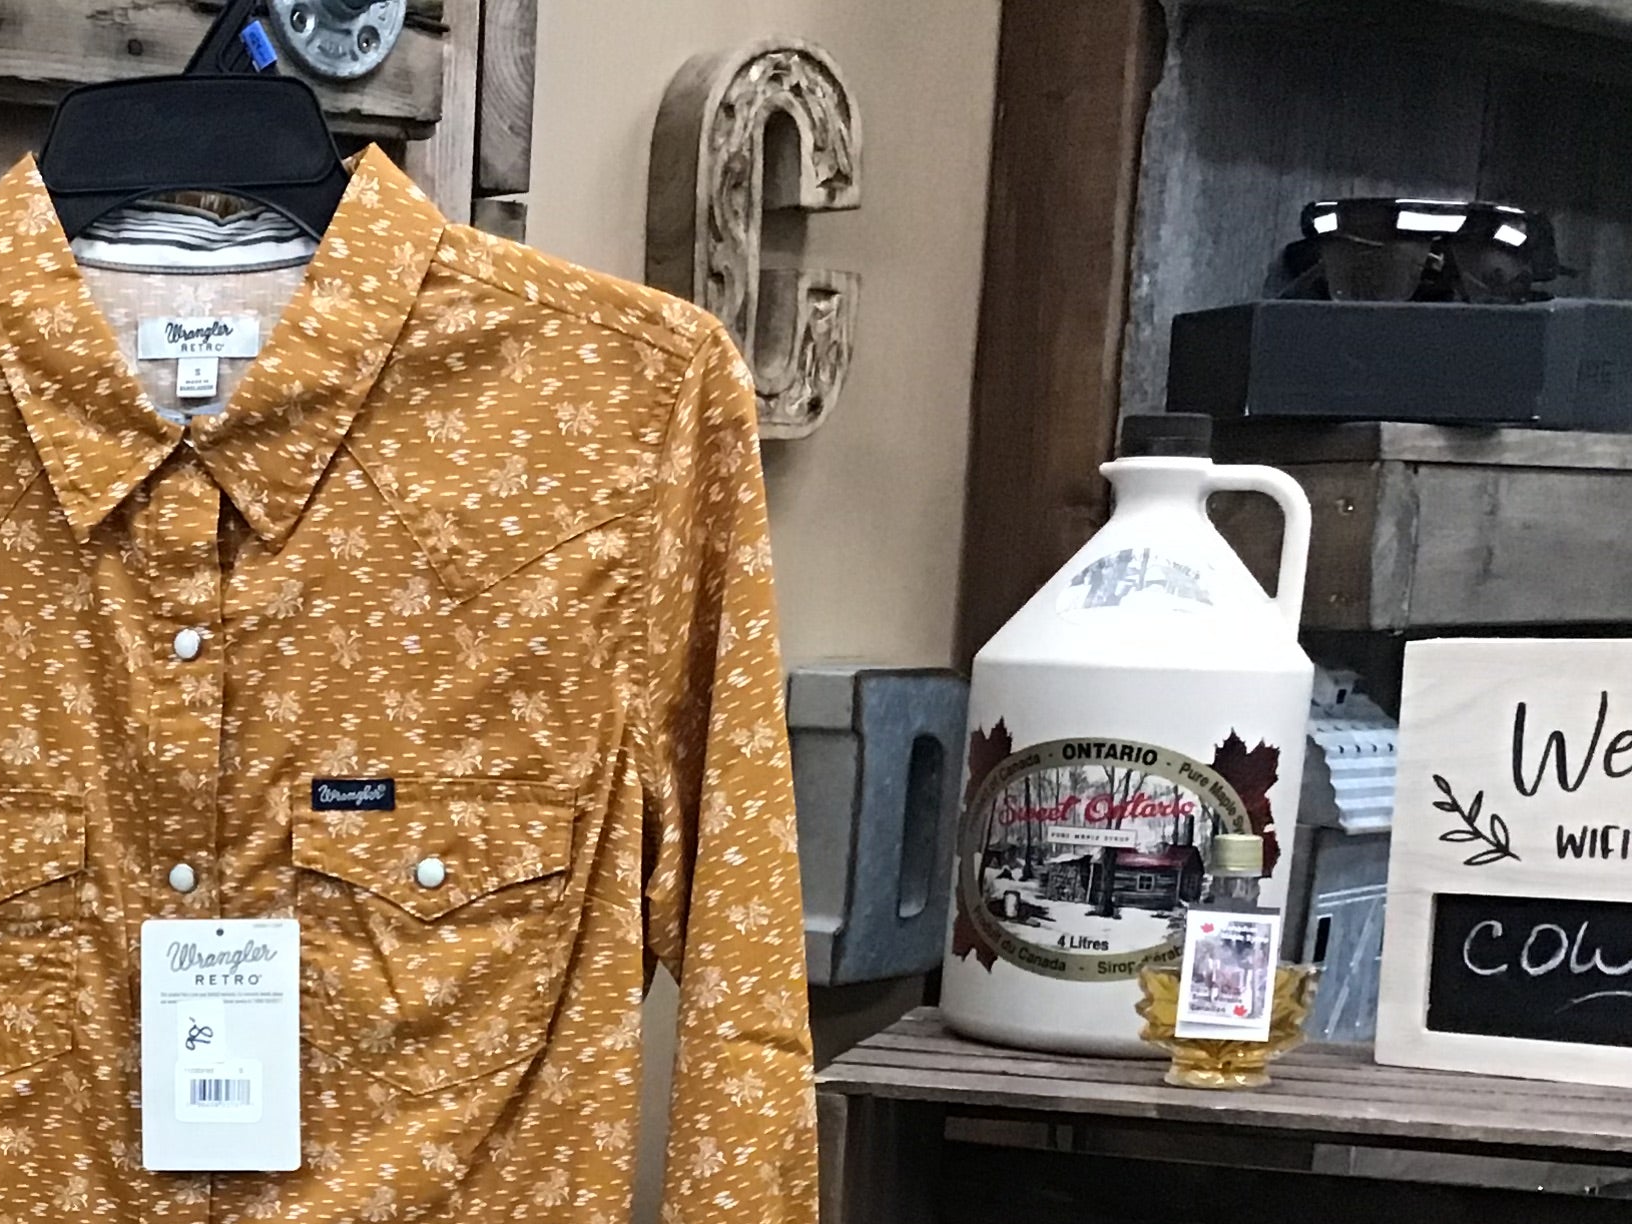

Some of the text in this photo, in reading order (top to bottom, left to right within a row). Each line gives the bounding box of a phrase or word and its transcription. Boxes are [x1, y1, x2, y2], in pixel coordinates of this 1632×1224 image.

[165, 321, 233, 344] Wrangler
[181, 343, 224, 352] RETRO
[1061, 742, 1158, 766] ONTARIO
[317, 784, 385, 806] Wrangler
[1179, 762, 1237, 817] Pure Maple
[999, 793, 1081, 826] Sweet
[1084, 791, 1196, 823] Ontario
[1057, 934, 1109, 951] 4 Litres
[166, 939, 278, 975] Wrangler
[1018, 947, 1066, 972] Canada
[195, 974, 262, 986] RETRO
